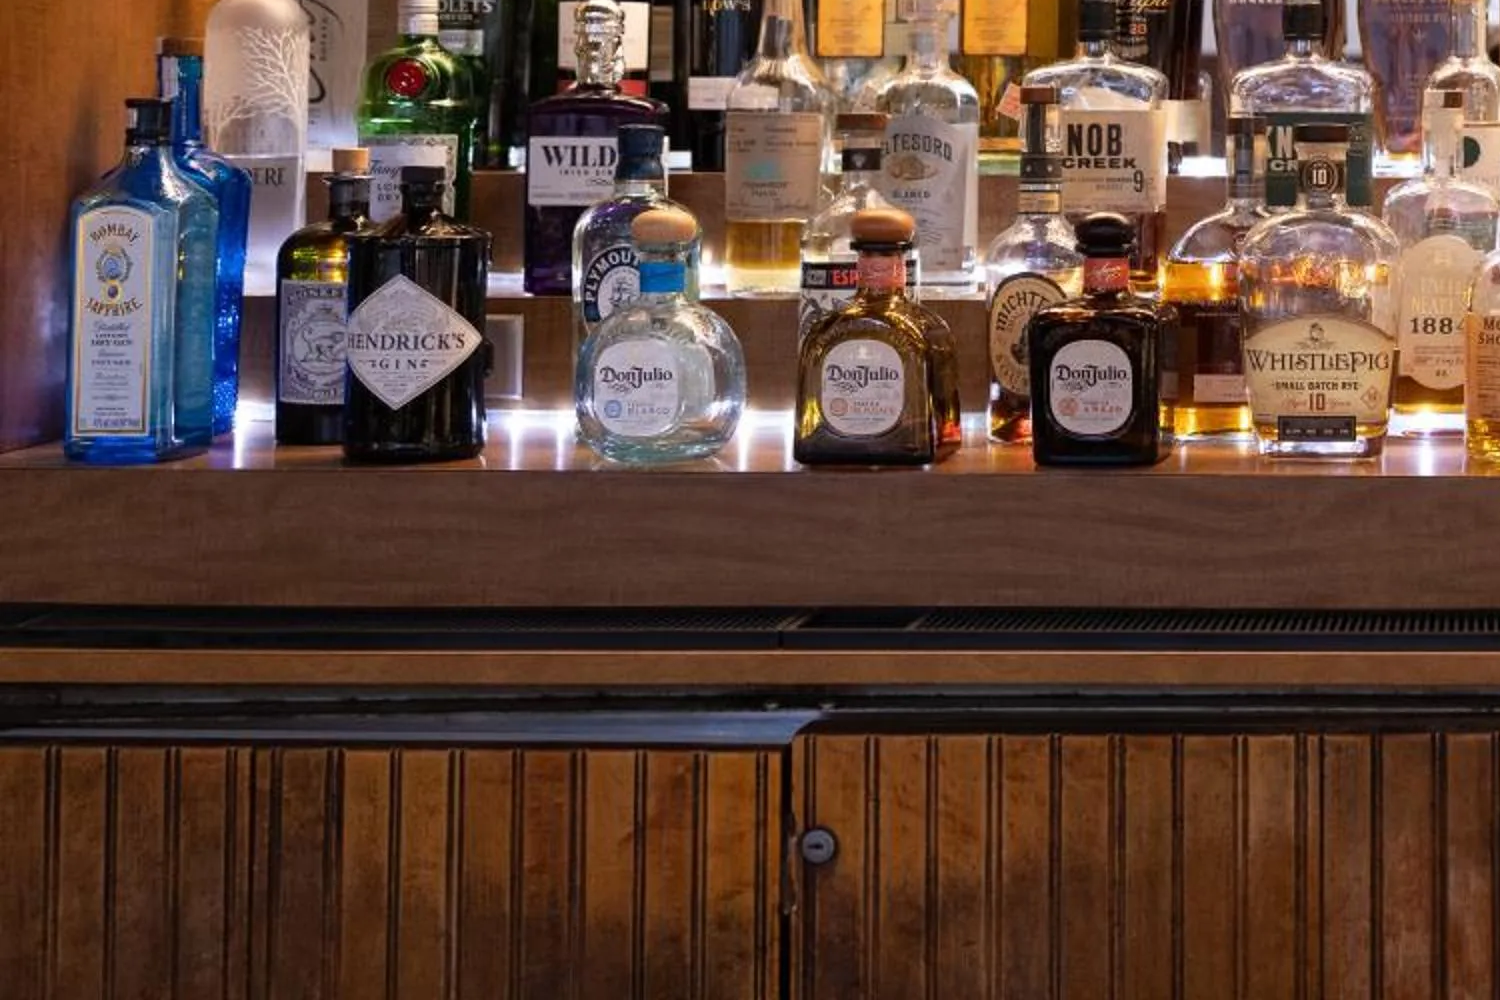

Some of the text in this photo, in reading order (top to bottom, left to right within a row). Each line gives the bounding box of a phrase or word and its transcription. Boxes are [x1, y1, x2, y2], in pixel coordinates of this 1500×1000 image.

[541, 145, 617, 168] WILD
[892, 133, 953, 161] TESORO
[1061, 157, 1137, 169] CREEK
[1133, 170, 1144, 193] 9
[89, 223, 140, 244] BOMBAY
[585, 250, 641, 302] PLYMOU
[86, 297, 143, 317] SAPPHIRE
[348, 332, 465, 350] HENDRICK'S
[379, 359, 417, 370] GIN
[1276, 381, 1305, 390] SMALL
[1307, 381, 1338, 390] BATCH
[1309, 393, 1326, 411] 10
